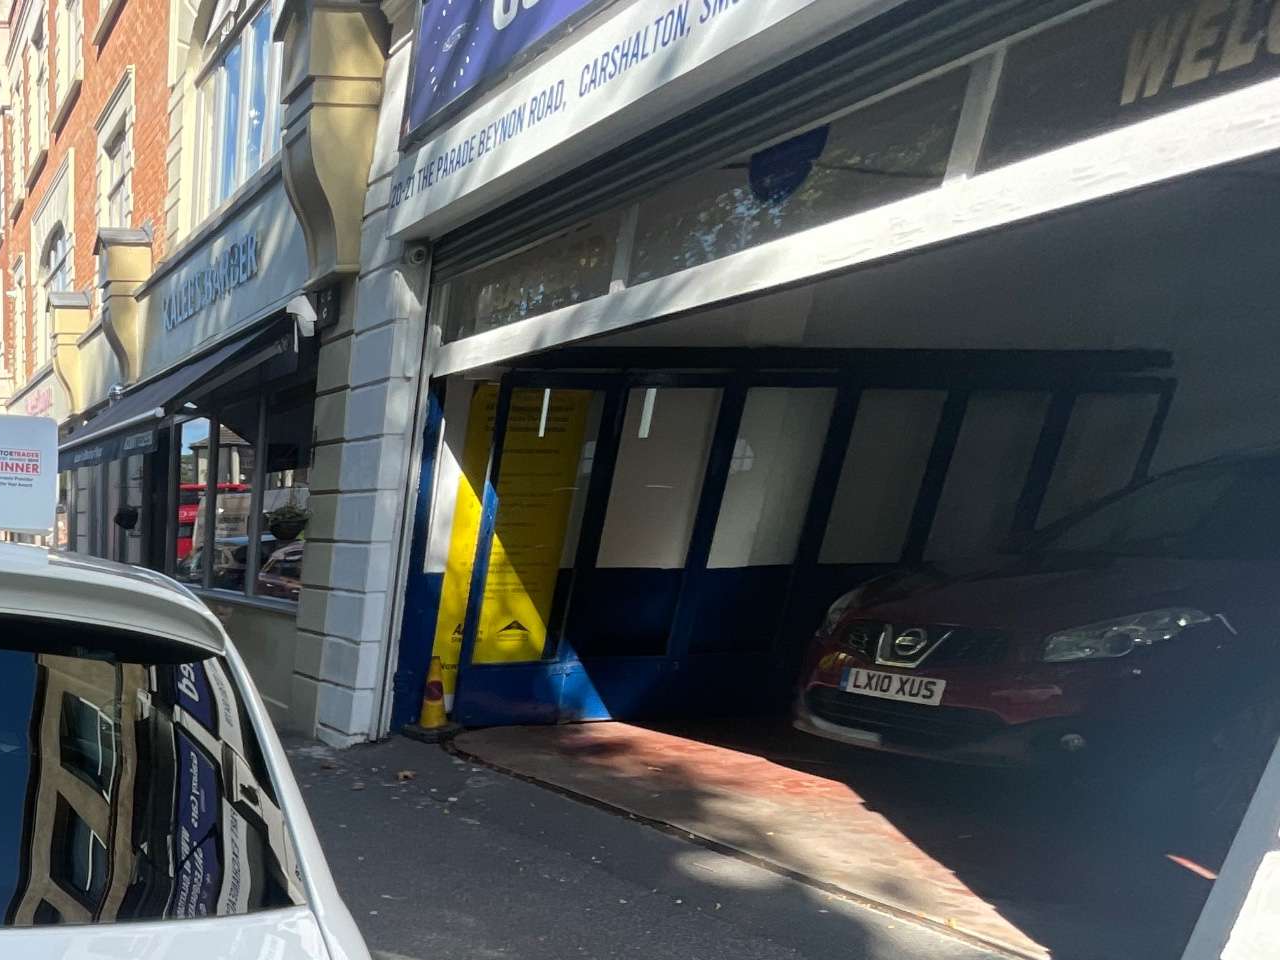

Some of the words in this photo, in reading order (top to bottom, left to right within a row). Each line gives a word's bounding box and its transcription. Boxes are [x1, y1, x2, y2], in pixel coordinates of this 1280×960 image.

[391, 173, 415, 209] 20-21
[417, 161, 435, 194] THE
[436, 135, 477, 183] PARADE
[477, 103, 527, 157] BEYNON
[528, 80, 567, 128] ROAD,
[579, 0, 691, 98] CARSHALTON,
[852, 670, 892, 693] LX10
[895, 676, 937, 700] XUS
